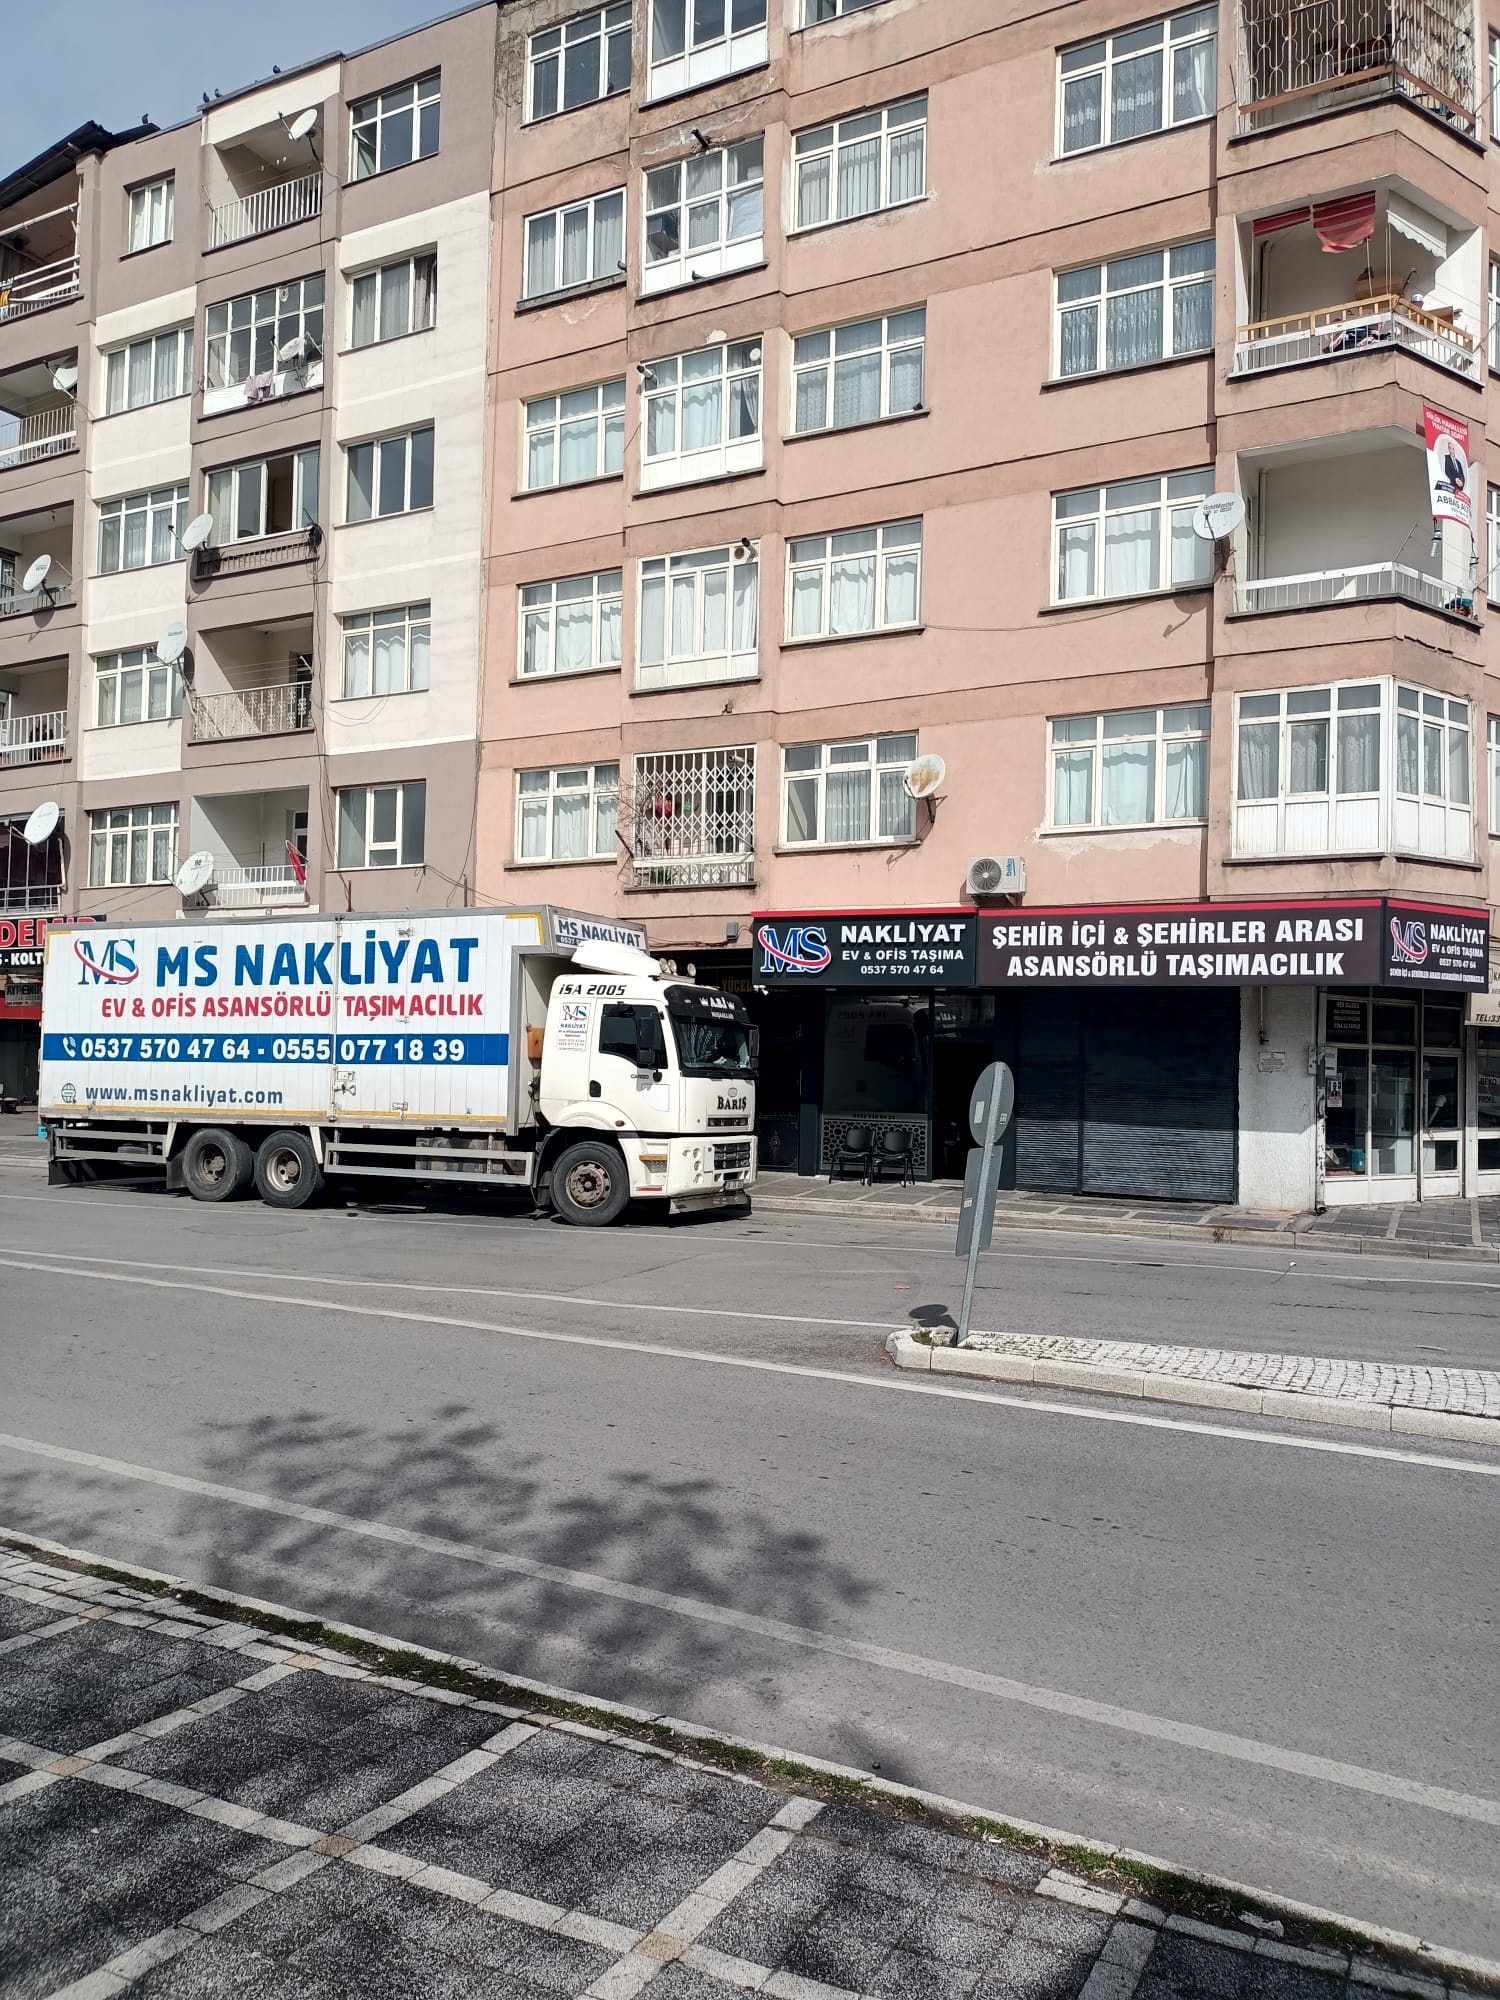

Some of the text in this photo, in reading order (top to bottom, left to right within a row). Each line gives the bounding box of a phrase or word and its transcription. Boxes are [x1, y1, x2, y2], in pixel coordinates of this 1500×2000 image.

[559, 920, 641, 947] MS NAKLİYAT
[841, 921, 966, 944] NAKLİYAT
[992, 917, 1363, 949] ŞEHİR İÇİ & ŞEHİRLER ARASI
[1390, 917, 1428, 964] MS
[1430, 924, 1485, 944] NAKLİYAT
[156, 930, 479, 987] MS NAKLİYAT
[758, 924, 832, 973] MS
[842, 947, 964, 962] EV & OFİS TAŞIMA
[1431, 944, 1440, 953] EV
[74, 938, 139, 986] MS
[860, 964, 944, 975] 0537 570 47 64
[1007, 950, 1345, 979] ASANSÖRLÜ TAŞIMACILIK
[586, 984, 627, 996] 2005
[101, 991, 484, 1022] EV & OFİS ASANSÖRLÜ TAŞIMACILIK
[81, 1038, 133, 1059] 0537
[140, 1038, 181, 1060] 570
[187, 1038, 215, 1060] 47
[222, 1038, 250, 1060] 64
[272, 1038, 331, 1061] 0555
[340, 1039, 390, 1061] 077
[394, 1039, 423, 1061] 18
[432, 1039, 465, 1062] 39
[85, 1085, 283, 1107] www.msnakliyat.com
[716, 1095, 747, 1112] BARIŞ
